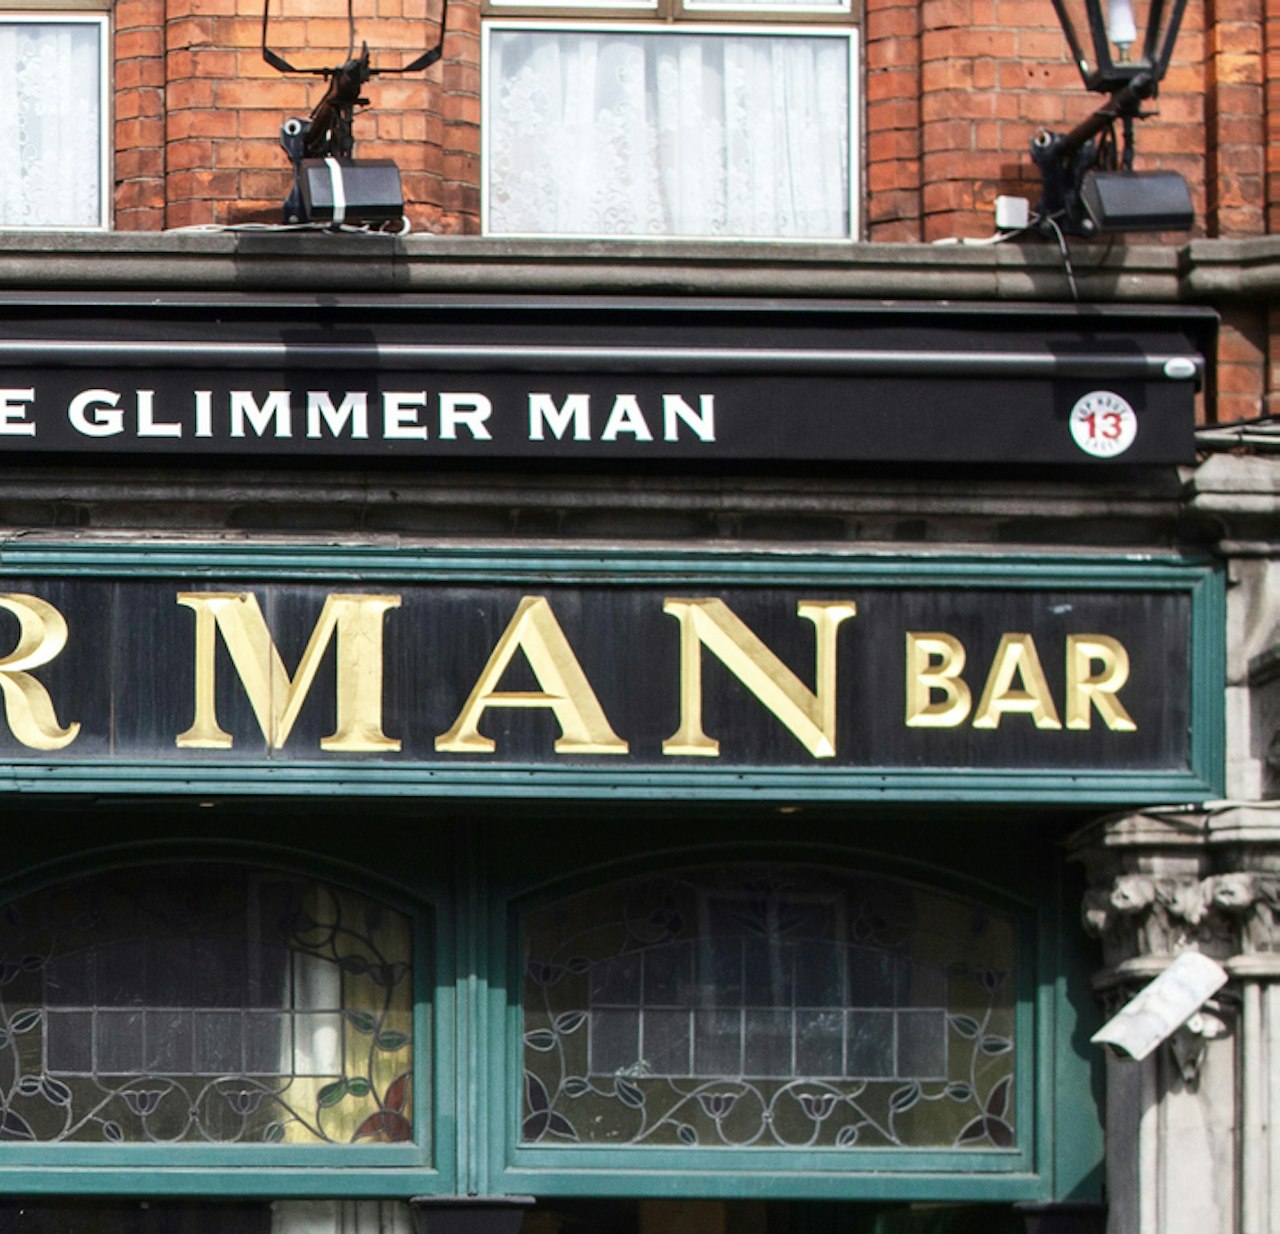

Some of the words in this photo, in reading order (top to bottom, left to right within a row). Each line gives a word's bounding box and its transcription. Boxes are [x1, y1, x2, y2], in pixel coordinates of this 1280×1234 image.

[68, 389, 493, 441] GLIMMER
[528, 393, 716, 442] MAN
[1081, 412, 1123, 439] 13
[176, 592, 857, 758] MAN
[905, 631, 1138, 732] BAR
